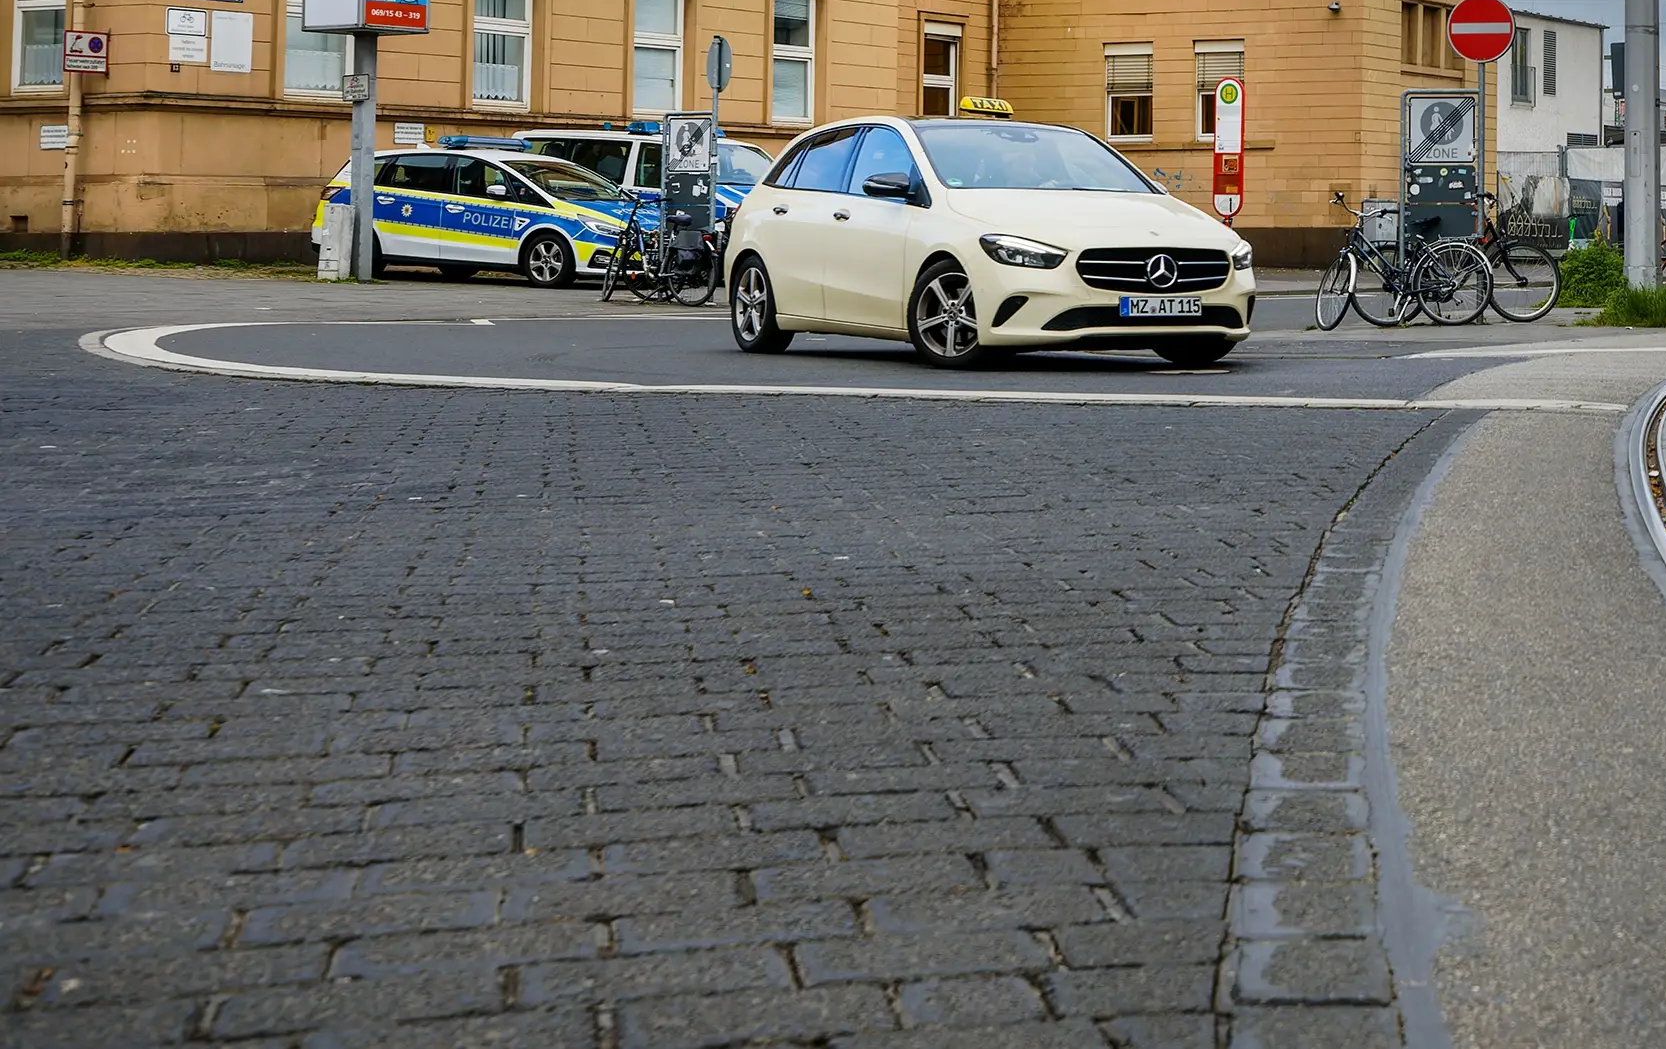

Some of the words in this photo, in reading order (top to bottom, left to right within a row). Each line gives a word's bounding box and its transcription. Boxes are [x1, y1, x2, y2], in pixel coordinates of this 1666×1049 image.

[371, 8, 394, 17] 069/15
[408, 11, 421, 20] 319
[971, 98, 1007, 111] TAXI
[1425, 148, 1459, 159] ZONE
[462, 212, 514, 230] POLIZEI
[1130, 299, 1148, 314] MZ
[1158, 299, 1175, 314] AT
[1178, 299, 1200, 314] 115
